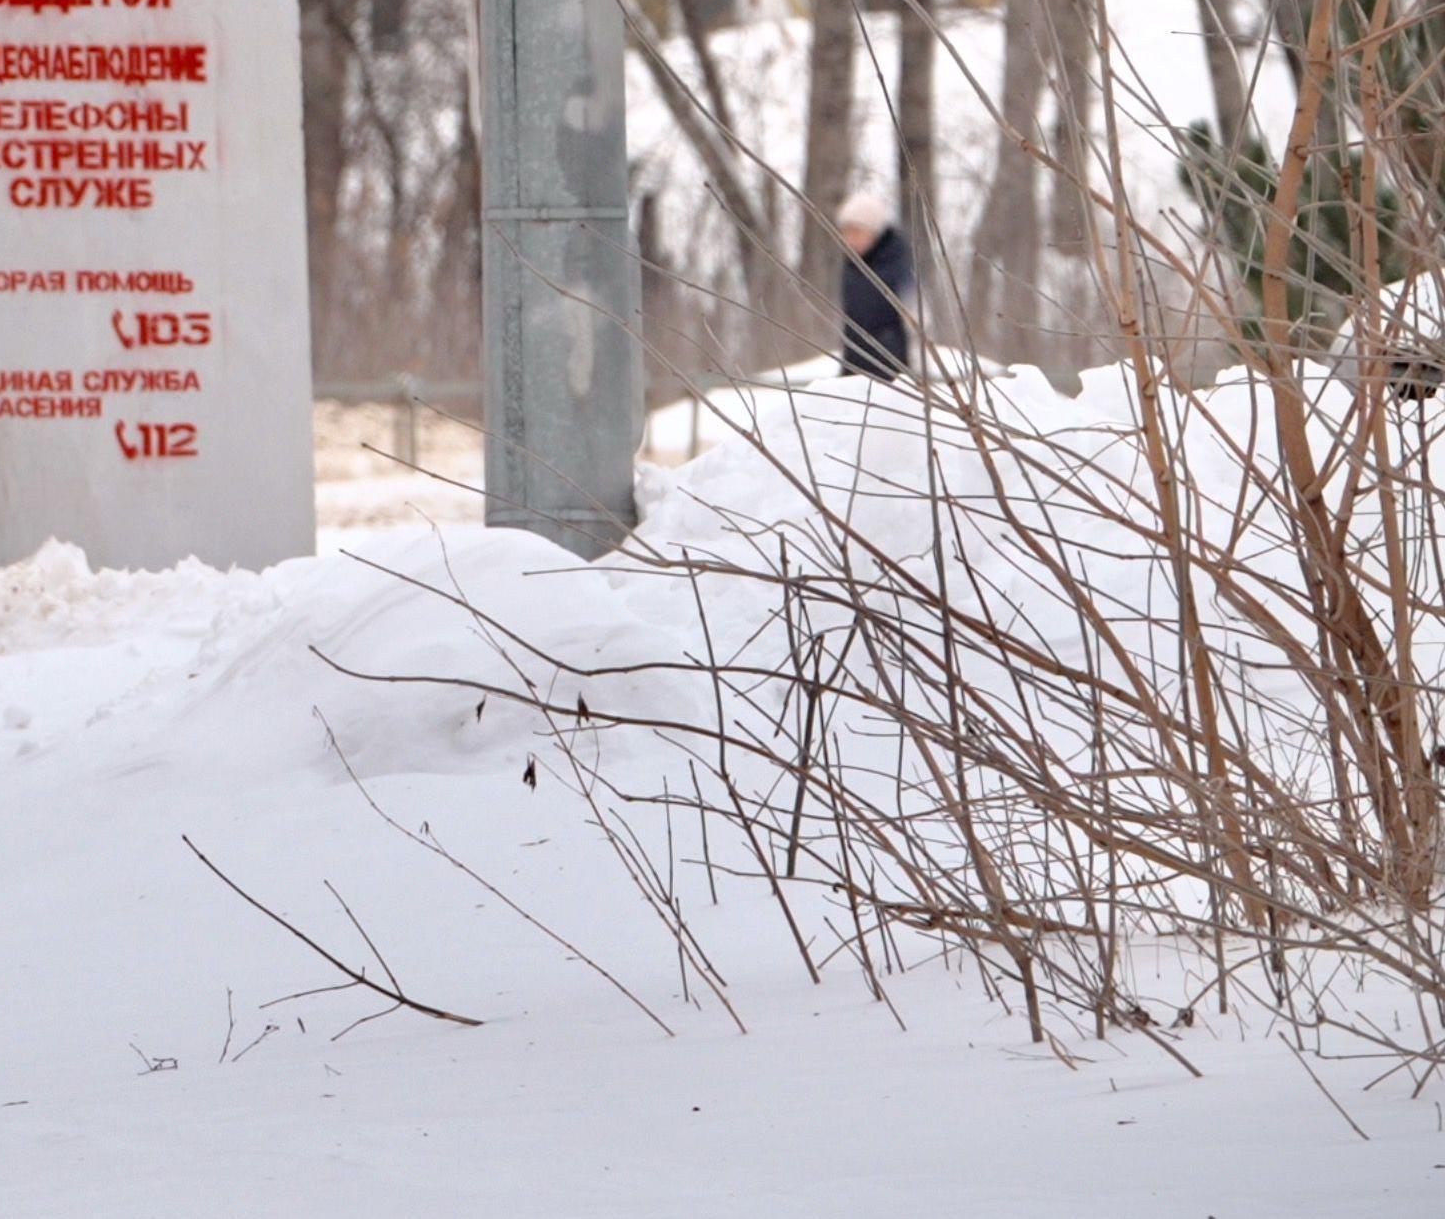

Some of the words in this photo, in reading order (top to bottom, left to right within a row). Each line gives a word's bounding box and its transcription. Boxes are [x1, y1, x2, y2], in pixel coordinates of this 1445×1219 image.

[9, 174, 154, 210] СЛУЖБ
[74, 269, 194, 295] ПОМОЩЬ
[135, 311, 212, 347] 103
[81, 369, 202, 394] СЛУЖБА
[137, 422, 198, 459] 112
